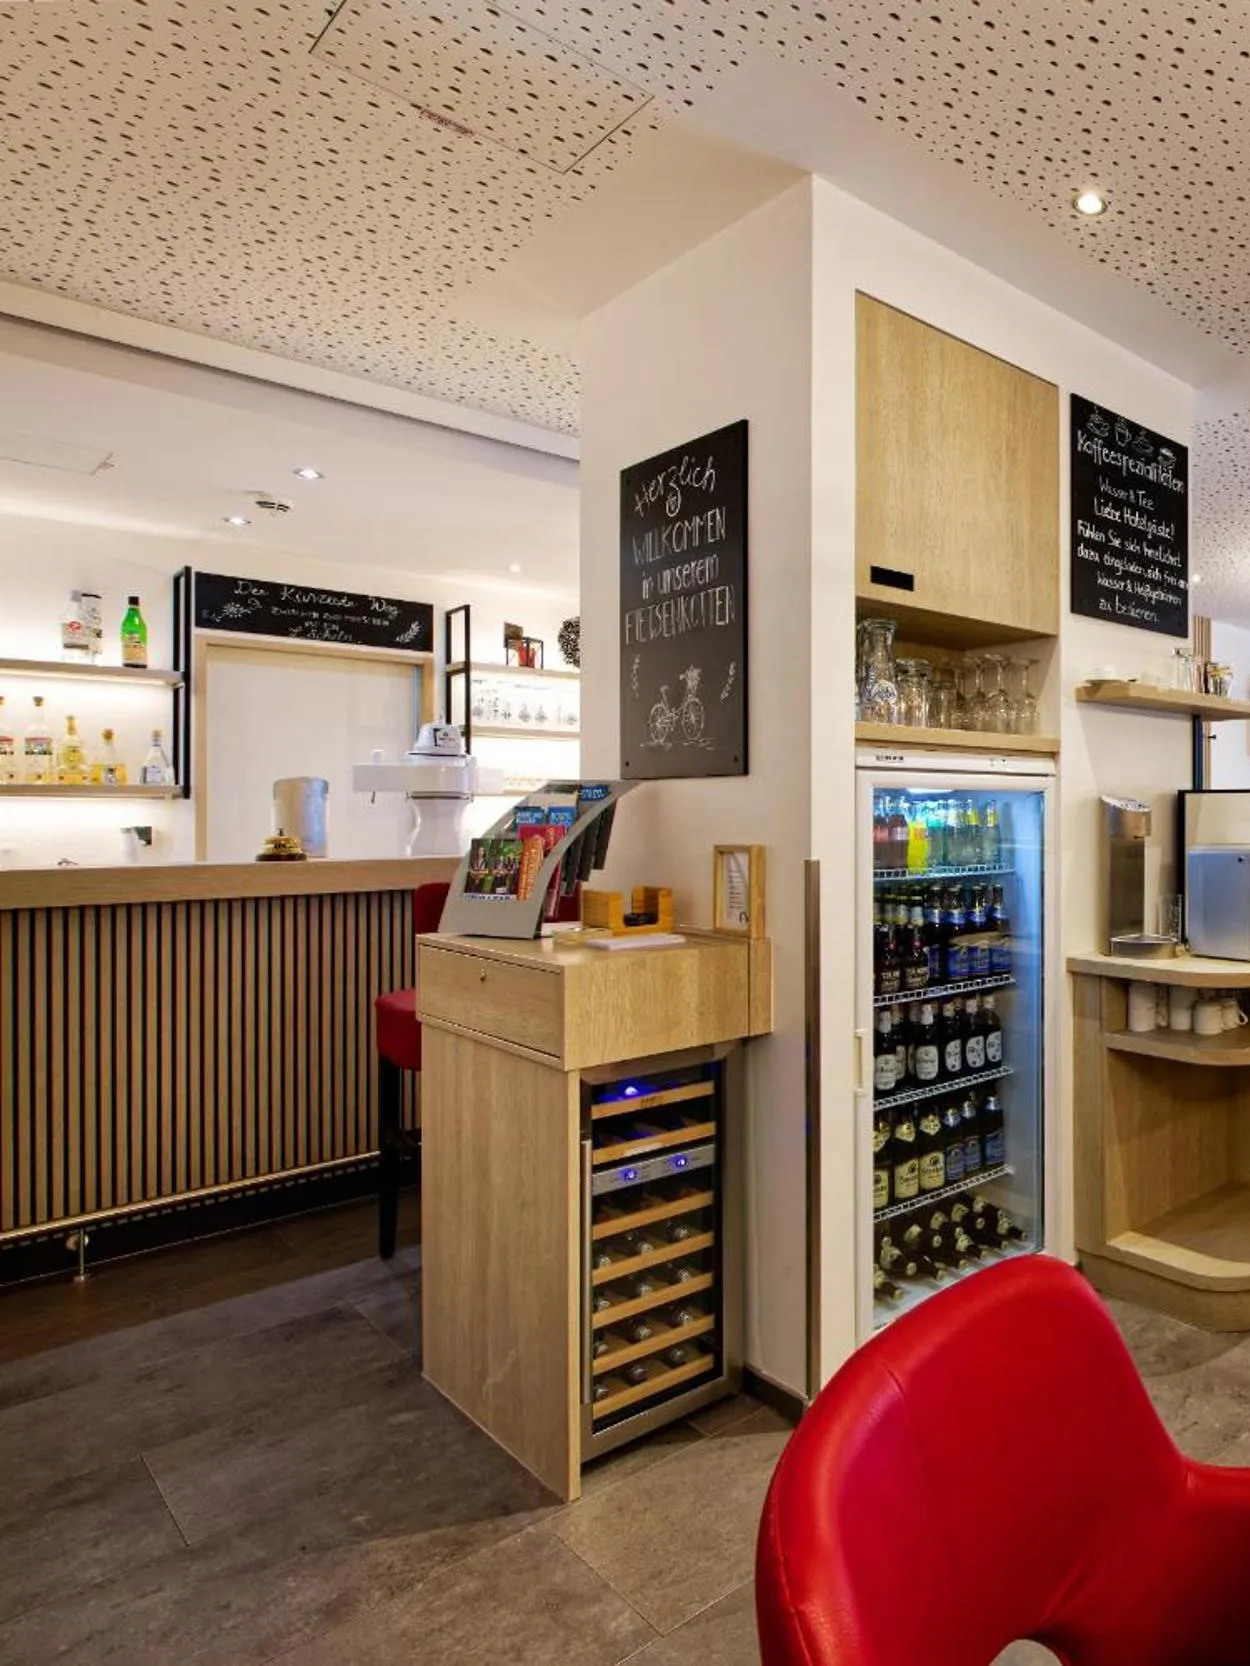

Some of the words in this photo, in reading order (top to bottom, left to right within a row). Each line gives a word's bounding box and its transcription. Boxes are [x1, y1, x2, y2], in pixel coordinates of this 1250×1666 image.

[633, 455, 717, 518] Herzlich
[1137, 491, 1155, 511] Tee
[631, 506, 726, 566] WILLKOMMEN
[641, 571, 654, 599] in
[657, 554, 719, 596] unserem
